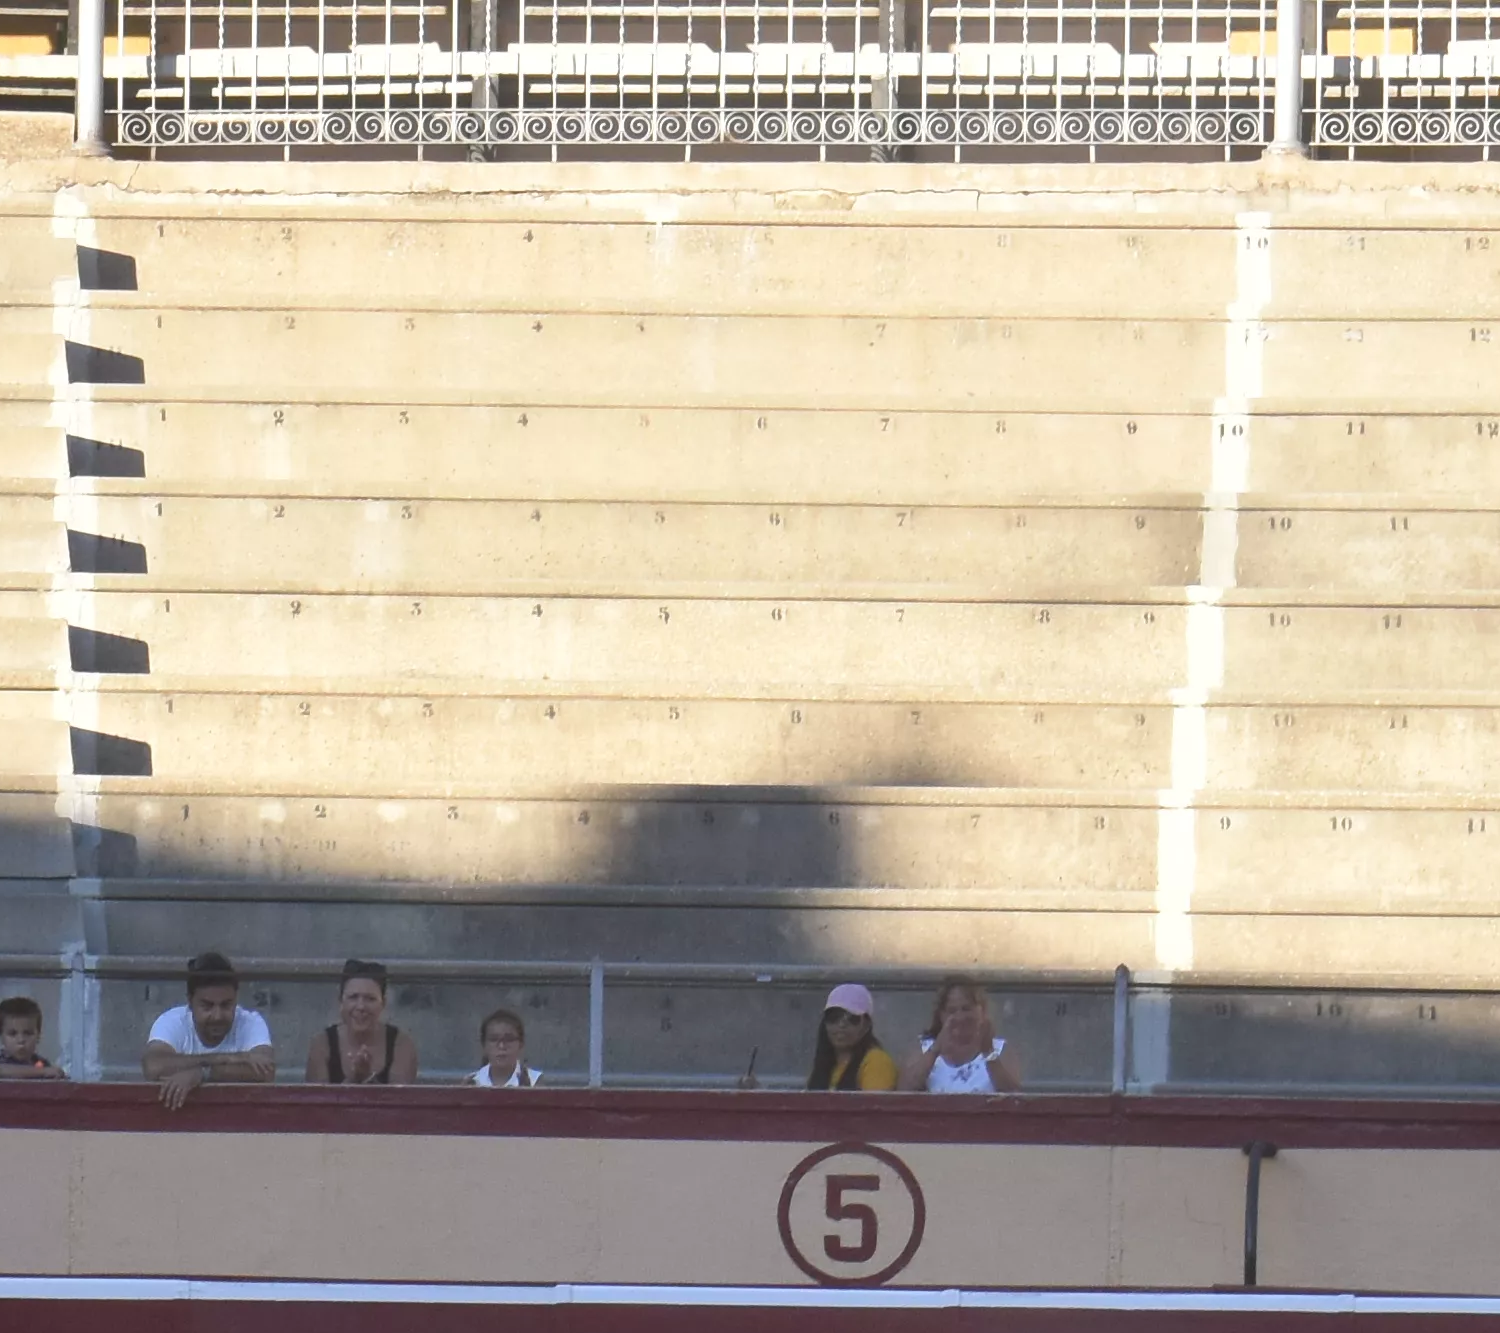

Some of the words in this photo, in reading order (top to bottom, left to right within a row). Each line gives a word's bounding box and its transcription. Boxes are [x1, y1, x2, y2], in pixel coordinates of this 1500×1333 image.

[523, 230, 533, 242] 4
[532, 321, 543, 332] 4
[518, 413, 528, 426] 4
[757, 417, 767, 429] 6
[880, 418, 890, 431] 7
[1127, 422, 1137, 434] 9
[1220, 424, 1243, 438] 10
[1348, 422, 1364, 435] 11
[1477, 422, 1499, 438] 12
[274, 505, 285, 518] 2
[531, 509, 541, 521] 4
[769, 512, 780, 525] 6
[1135, 515, 1146, 530] 9
[1269, 517, 1292, 530] 10
[1391, 517, 1408, 531] 11
[290, 601, 302, 616] 2
[532, 604, 542, 617] 4
[771, 609, 782, 620] 6
[1039, 609, 1050, 623] 8
[1144, 612, 1155, 623] 9
[1269, 613, 1291, 627] 10
[1383, 614, 1402, 629] 11
[299, 702, 311, 715] 2
[545, 705, 556, 719] 4
[315, 805, 326, 818] 2
[1220, 817, 1231, 829] 9
[1331, 817, 1352, 830] 10
[1468, 819, 1485, 834] 11
[1417, 1007, 1437, 1021] 11
[823, 1174, 881, 1263] 5
